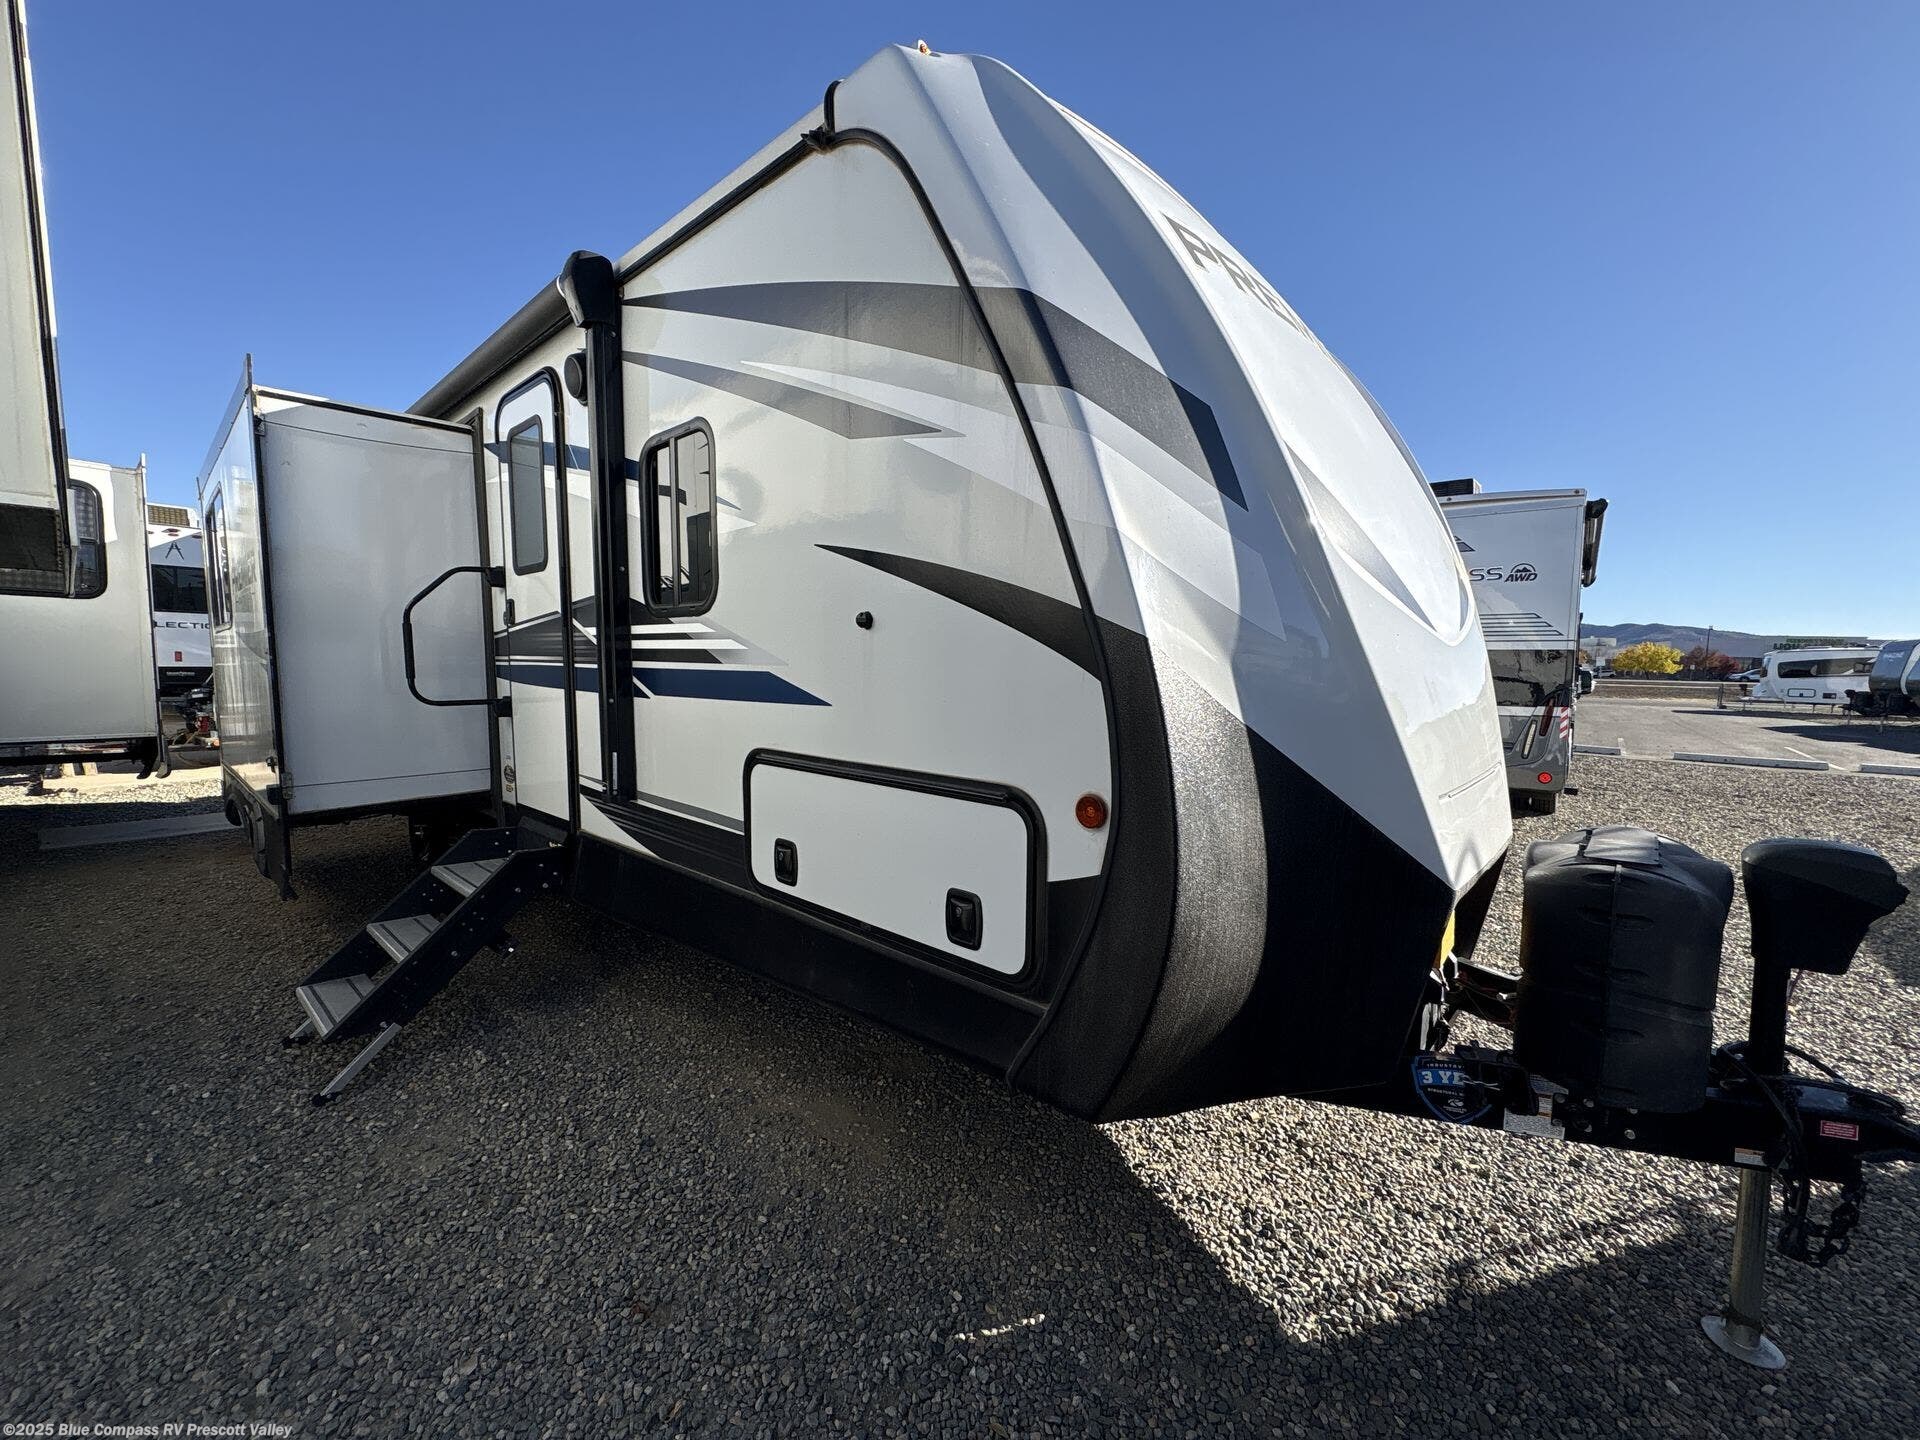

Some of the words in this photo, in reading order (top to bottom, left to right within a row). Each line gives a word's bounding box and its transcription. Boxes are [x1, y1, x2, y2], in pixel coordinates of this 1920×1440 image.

[1159, 211, 1315, 343] PRE
[1469, 567, 1503, 582] SS
[1504, 572, 1538, 583] AWD
[1421, 1070, 1433, 1084] 3
[1438, 1070, 1465, 1086] YE
